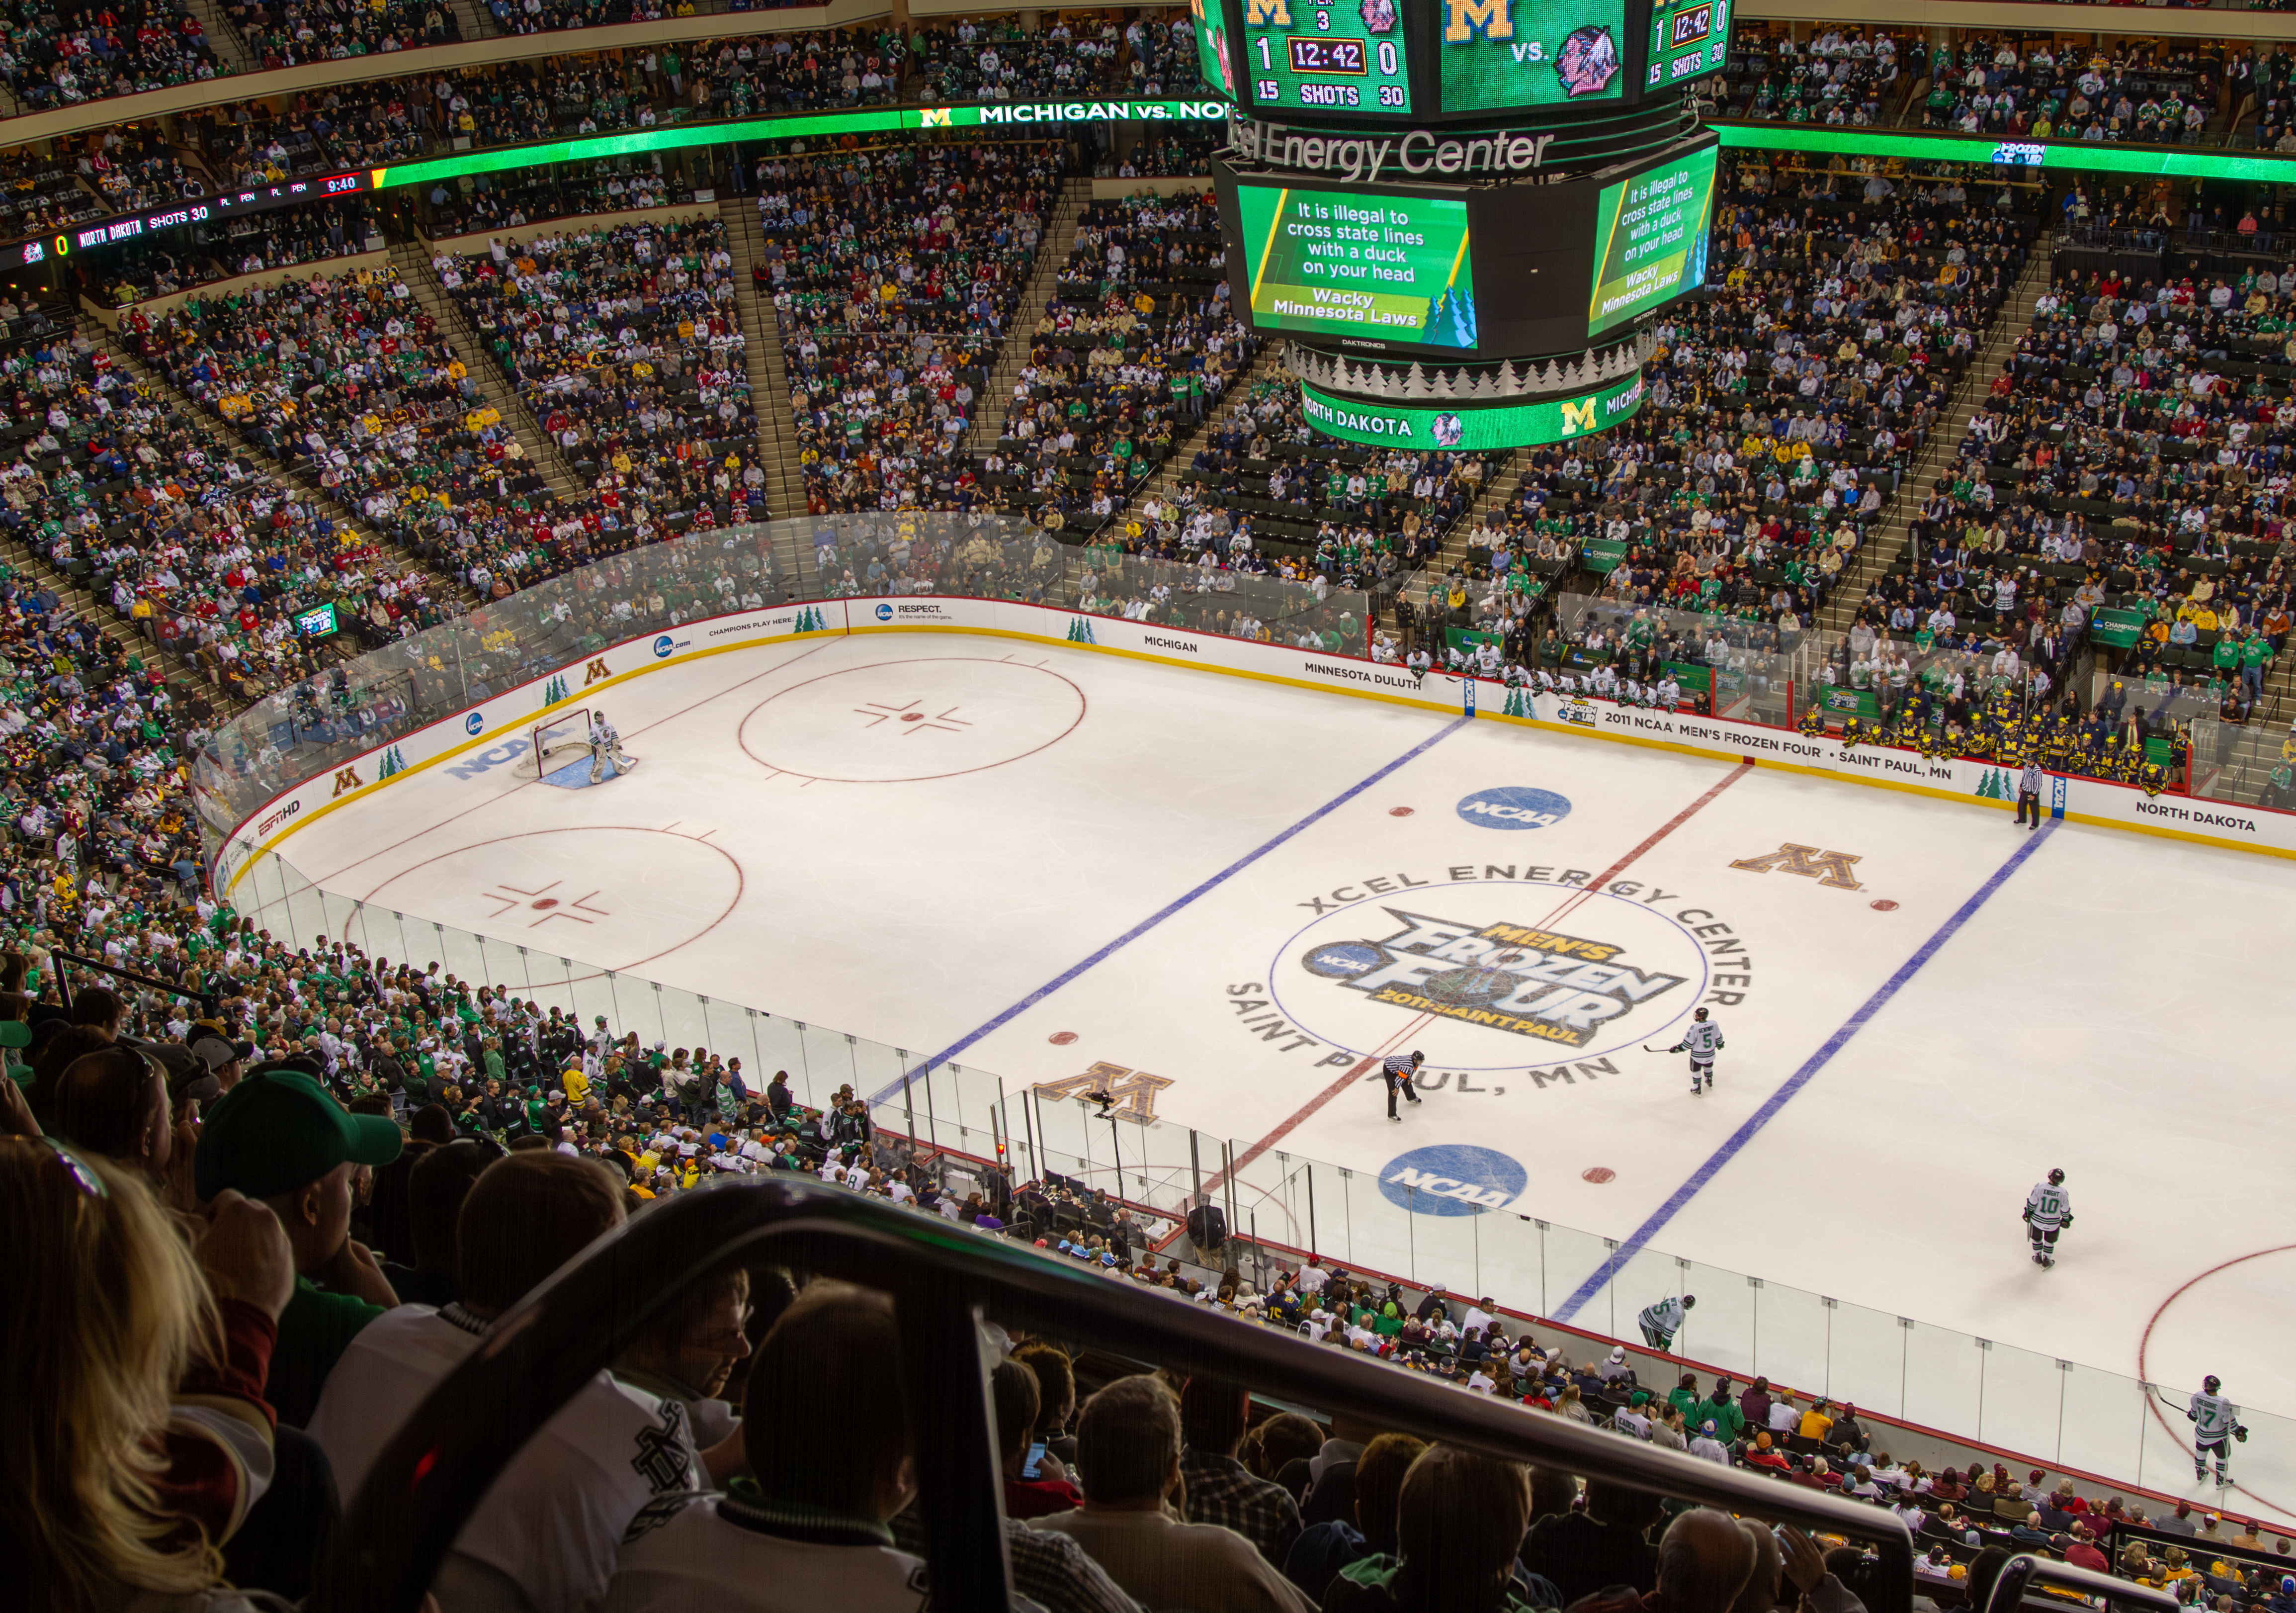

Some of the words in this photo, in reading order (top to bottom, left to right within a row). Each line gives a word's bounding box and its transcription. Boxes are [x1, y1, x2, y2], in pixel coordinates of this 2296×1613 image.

[1317, 11, 1329, 30] 3
[1656, 19, 1664, 52] 1
[1675, 9, 1708, 40] 12:42
[1716, 0, 1727, 32] 0
[1257, 37, 1271, 70] 1
[1295, 42, 1360, 68] 12:42
[1378, 42, 1397, 75] 0
[1649, 63, 1662, 84] 15
[1671, 51, 1702, 79] SHOTS
[1711, 42, 1724, 63] 30
[1259, 80, 1279, 99] 15
[1300, 84, 1359, 105] SHOTS
[1379, 87, 1404, 106] 30
[920, 108, 952, 127] M
[979, 102, 1129, 123] MICHIGAN
[1228, 110, 1262, 160] cel
[1266, 123, 1390, 182] Energy
[1400, 130, 1554, 173] Center
[2000, 142, 2046, 155] FROZEN
[328, 177, 355, 192] 9:40
[1631, 189, 1638, 204] It
[1640, 186, 1647, 200] is
[1650, 172, 1677, 196] illegal
[1679, 171, 1688, 184] to
[1299, 203, 1310, 218] It
[1316, 204, 1328, 219] is
[1334, 205, 1384, 225] illegal
[1390, 210, 1409, 226] to
[1622, 208, 1646, 226] cross
[1648, 196, 1671, 217] state
[1673, 186, 1693, 205] lines
[55, 236, 68, 256] 0
[78, 229, 107, 248] NORTH
[109, 220, 142, 241] DAKOTA
[150, 211, 187, 229] SHOTS
[191, 207, 208, 221] 30
[220, 198, 231, 207] PL
[241, 192, 255, 202] PEN
[271, 188, 281, 196] PL
[292, 183, 307, 193] PEN
[1631, 222, 1650, 241] with
[1652, 220, 1658, 231] a
[1660, 207, 1682, 229] duck
[1288, 224, 1331, 238] cross
[1337, 225, 1379, 243] state
[1385, 228, 1424, 246] lines
[1625, 247, 1636, 262] on
[1639, 239, 1659, 258] your
[1662, 223, 1684, 246] head
[1308, 242, 1344, 257] with
[1350, 247, 1360, 260] a
[1365, 246, 1407, 263] duck
[1303, 261, 1324, 274] on
[1329, 264, 1367, 278] your
[1373, 264, 1415, 283] head
[1626, 264, 1659, 289] Wacky
[1313, 288, 1373, 309] Wacky
[1602, 286, 1651, 315] Minnesota
[1654, 271, 1678, 291] Laws
[1274, 299, 1364, 322] Minnesota
[1371, 309, 1417, 327] Laws
[1634, 308, 1657, 323] DAKTRONICS
[1342, 339, 1385, 349] DAKTRONICS
[1303, 394, 1333, 423] NORTH
[1337, 411, 1412, 437] DAKOTA
[1561, 397, 1597, 436] M
[299, 610, 332, 626] FROZEN
[709, 624, 751, 636] CHAMPIONS
[2105, 622, 2142, 632] CHAMPIONS
[1144, 635, 1197, 653] MICHIGAN
[584, 657, 611, 686] M
[1305, 662, 1371, 682] MINNESOTA
[1374, 674, 1422, 691] DULUTH
[1465, 678, 1474, 707] NCAA
[1563, 701, 1597, 715] FROZEN
[1997, 707, 2009, 718] M
[468, 720, 484, 731] NCAA
[1903, 727, 1915, 736] M
[1606, 713, 1630, 725] 2011
[1635, 717, 1673, 733] NCAA
[1680, 724, 1720, 740] MEN'S
[1724, 731, 1779, 752] FROZEN
[1783, 742, 1820, 758] FOUR
[1839, 751, 1881, 768] SAINT
[1885, 759, 1925, 777] PAUL,
[1930, 766, 1952, 780] MN
[2005, 740, 2017, 750] M
[2026, 734, 2039, 743] M
[2101, 757, 2112, 766] M
[333, 766, 363, 798] M
[2054, 777, 2064, 808] NCAA
[1470, 801, 1556, 827] NCAA
[2136, 801, 2189, 820] NORTH
[2193, 811, 2256, 832] DAKOTA
[1728, 842, 1864, 891] M
[1296, 872, 1428, 916] XCEL
[1447, 865, 1681, 906] ENERGY
[1676, 909, 1752, 1006] CENTER
[1481, 925, 1616, 960] MEN'S
[1315, 954, 1370, 973] NCAA
[1383, 914, 1679, 1001] FROZEN
[1226, 982, 1319, 1053] SAINT
[1313, 1051, 1505, 1095] PUL,
[1530, 1057, 1621, 1089] MN
[1702, 1033, 1712, 1049] 5
[1386, 1168, 1509, 1209] NCAA
[2043, 1189, 2060, 1197] KNIGHT
[2040, 1196, 2060, 1214] 10
[1270, 1306, 1282, 1319] 15
[2197, 1398, 2218, 1411] GREGOIRE
[2198, 1406, 2217, 1430] 17
